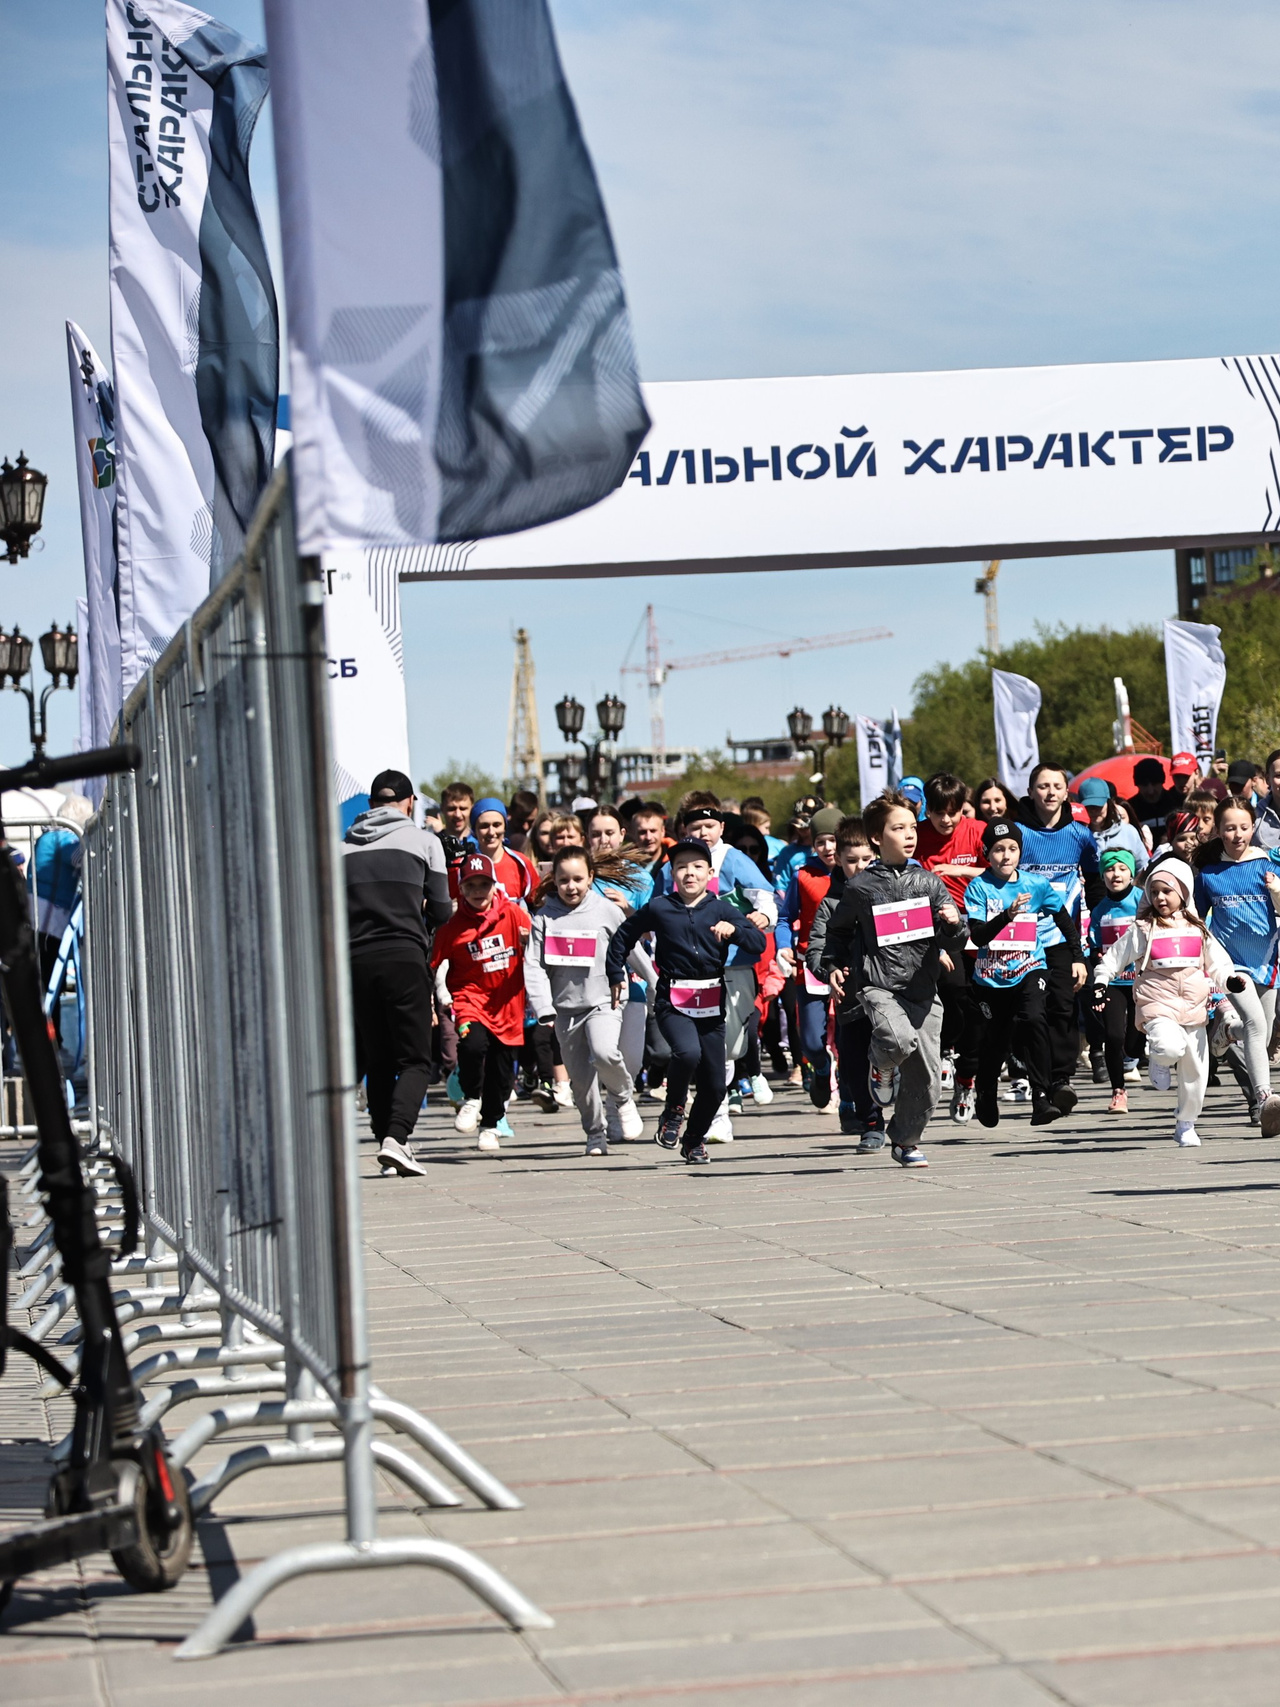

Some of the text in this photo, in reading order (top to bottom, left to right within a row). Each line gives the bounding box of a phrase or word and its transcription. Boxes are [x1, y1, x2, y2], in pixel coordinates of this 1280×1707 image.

[125, 1, 160, 213] СТАЛЬНО
[620, 424, 1235, 487] АЛЬНОЙ ХАРАКТЕР
[328, 657, 359, 679] СБ
[901, 918, 908, 930] 1
[1008, 928, 1015, 939] 1
[567, 944, 573, 955] 1
[1174, 944, 1180, 956] 1
[695, 996, 700, 1007] 1
